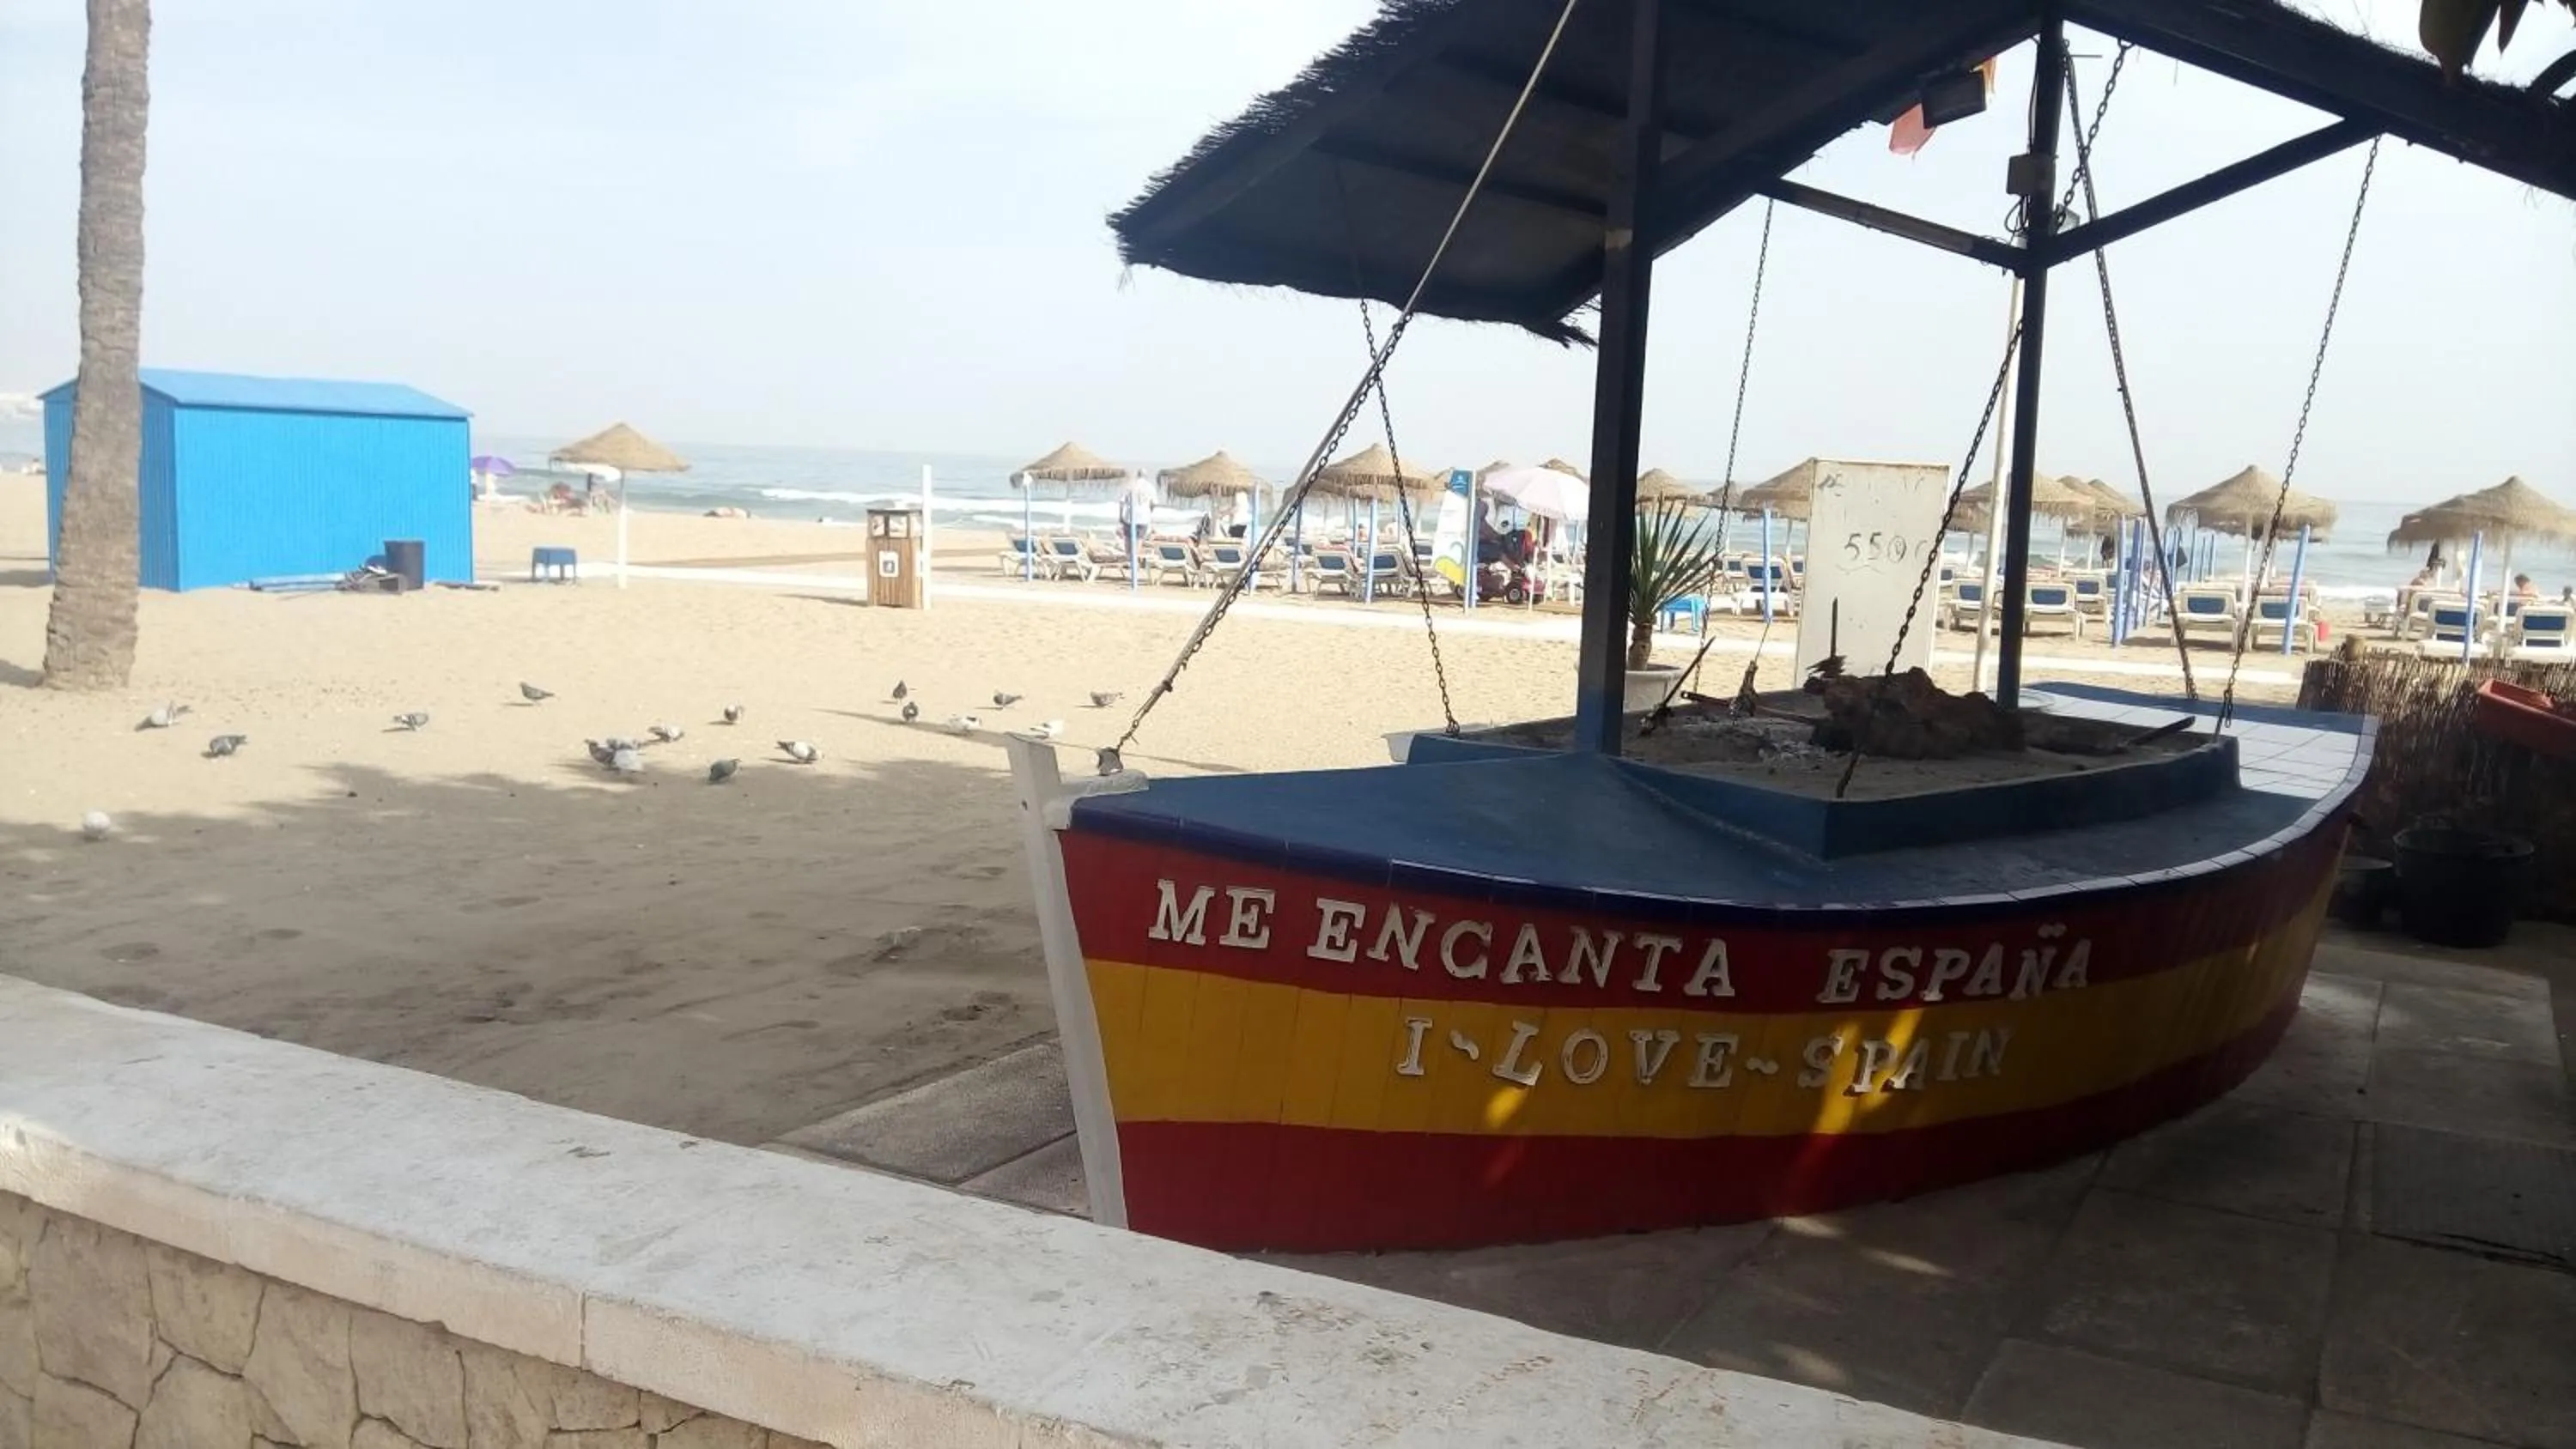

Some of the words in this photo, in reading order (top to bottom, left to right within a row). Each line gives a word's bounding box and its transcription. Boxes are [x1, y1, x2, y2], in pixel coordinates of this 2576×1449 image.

[1147, 878, 1276, 949] ME
[1306, 897, 1735, 997] ENCANTA
[1815, 921, 2093, 1003] ESPAÑA
